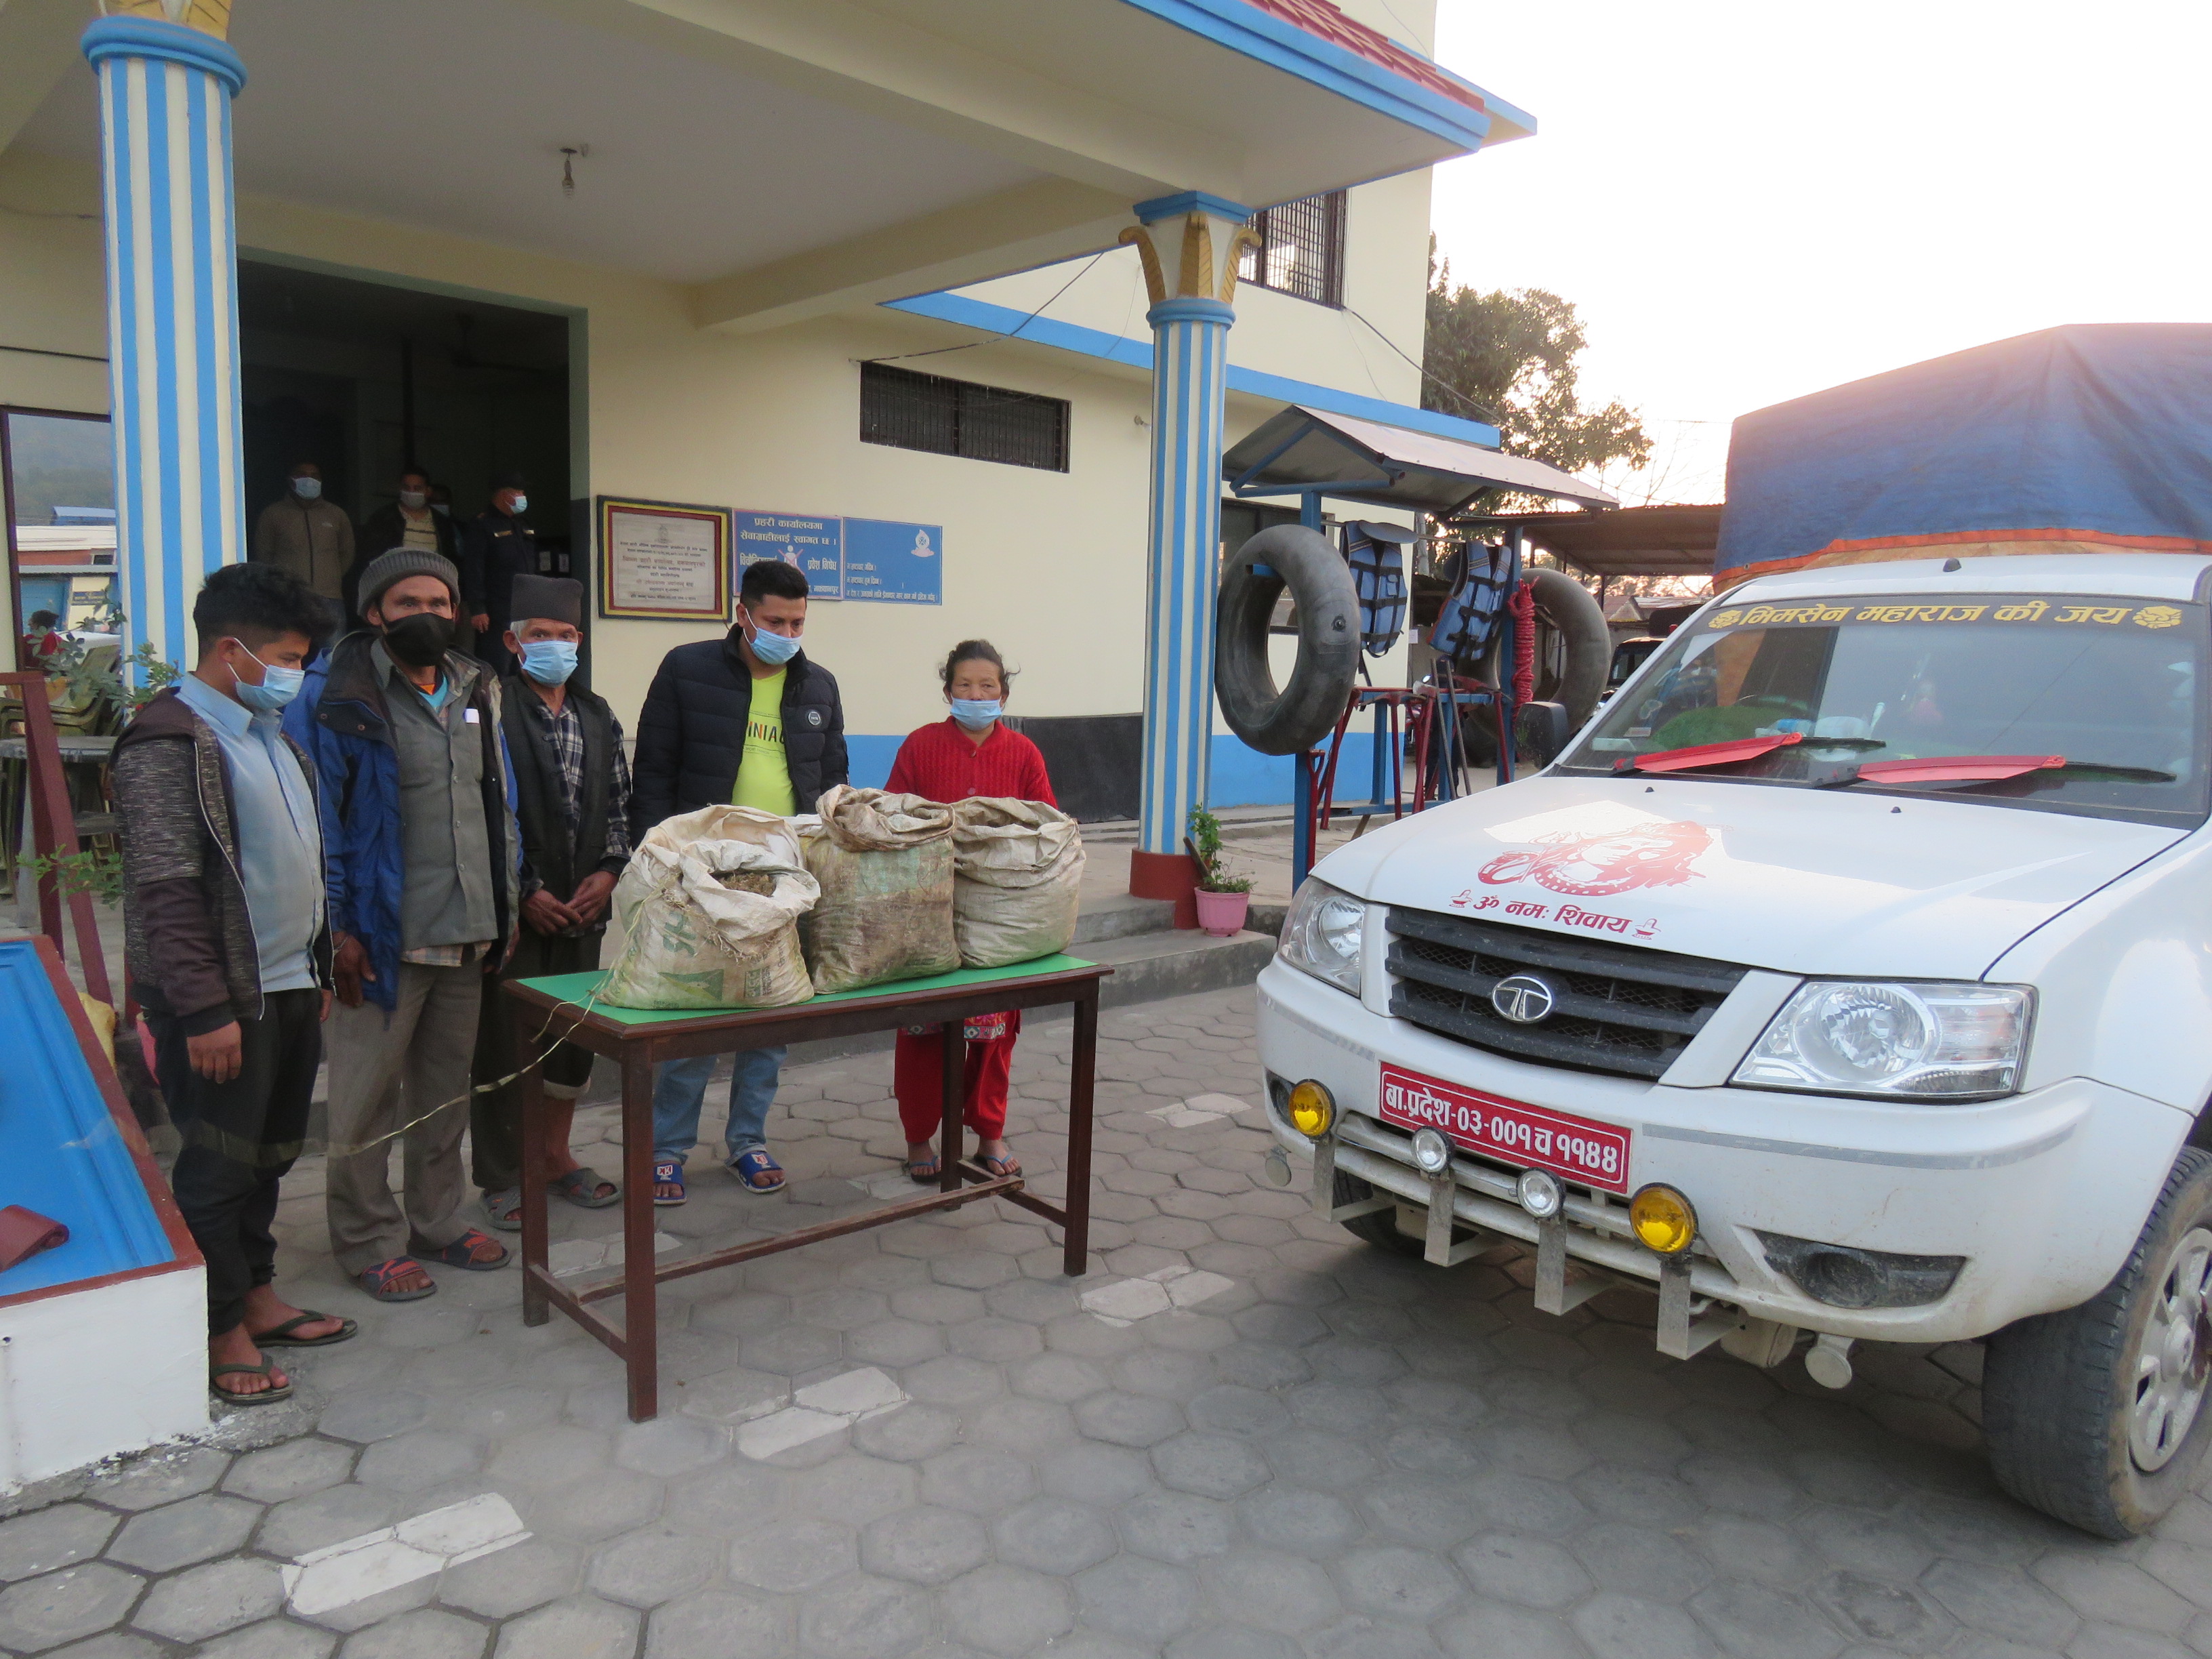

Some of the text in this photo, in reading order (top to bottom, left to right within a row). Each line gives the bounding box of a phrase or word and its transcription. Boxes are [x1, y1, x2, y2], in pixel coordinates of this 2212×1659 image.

[754, 517, 823, 530] प्रहरी कार्यालयमा
[741, 529, 790, 544] सेवाग्राहीलाई
[794, 535, 819, 544] स्वागत
[821, 537, 830, 546] छ
[807, 557, 820, 571] प्रवेश
[822, 557, 837, 571] निषेध
[814, 585, 839, 594] मकवानपुर
[1738, 600, 2133, 626] भिमसेन महाराज की जय
[1554, 903, 1633, 934] शिवाय
[1534, 1126, 1553, 1155] च
[1556, 1134, 1617, 1173] ११४४
